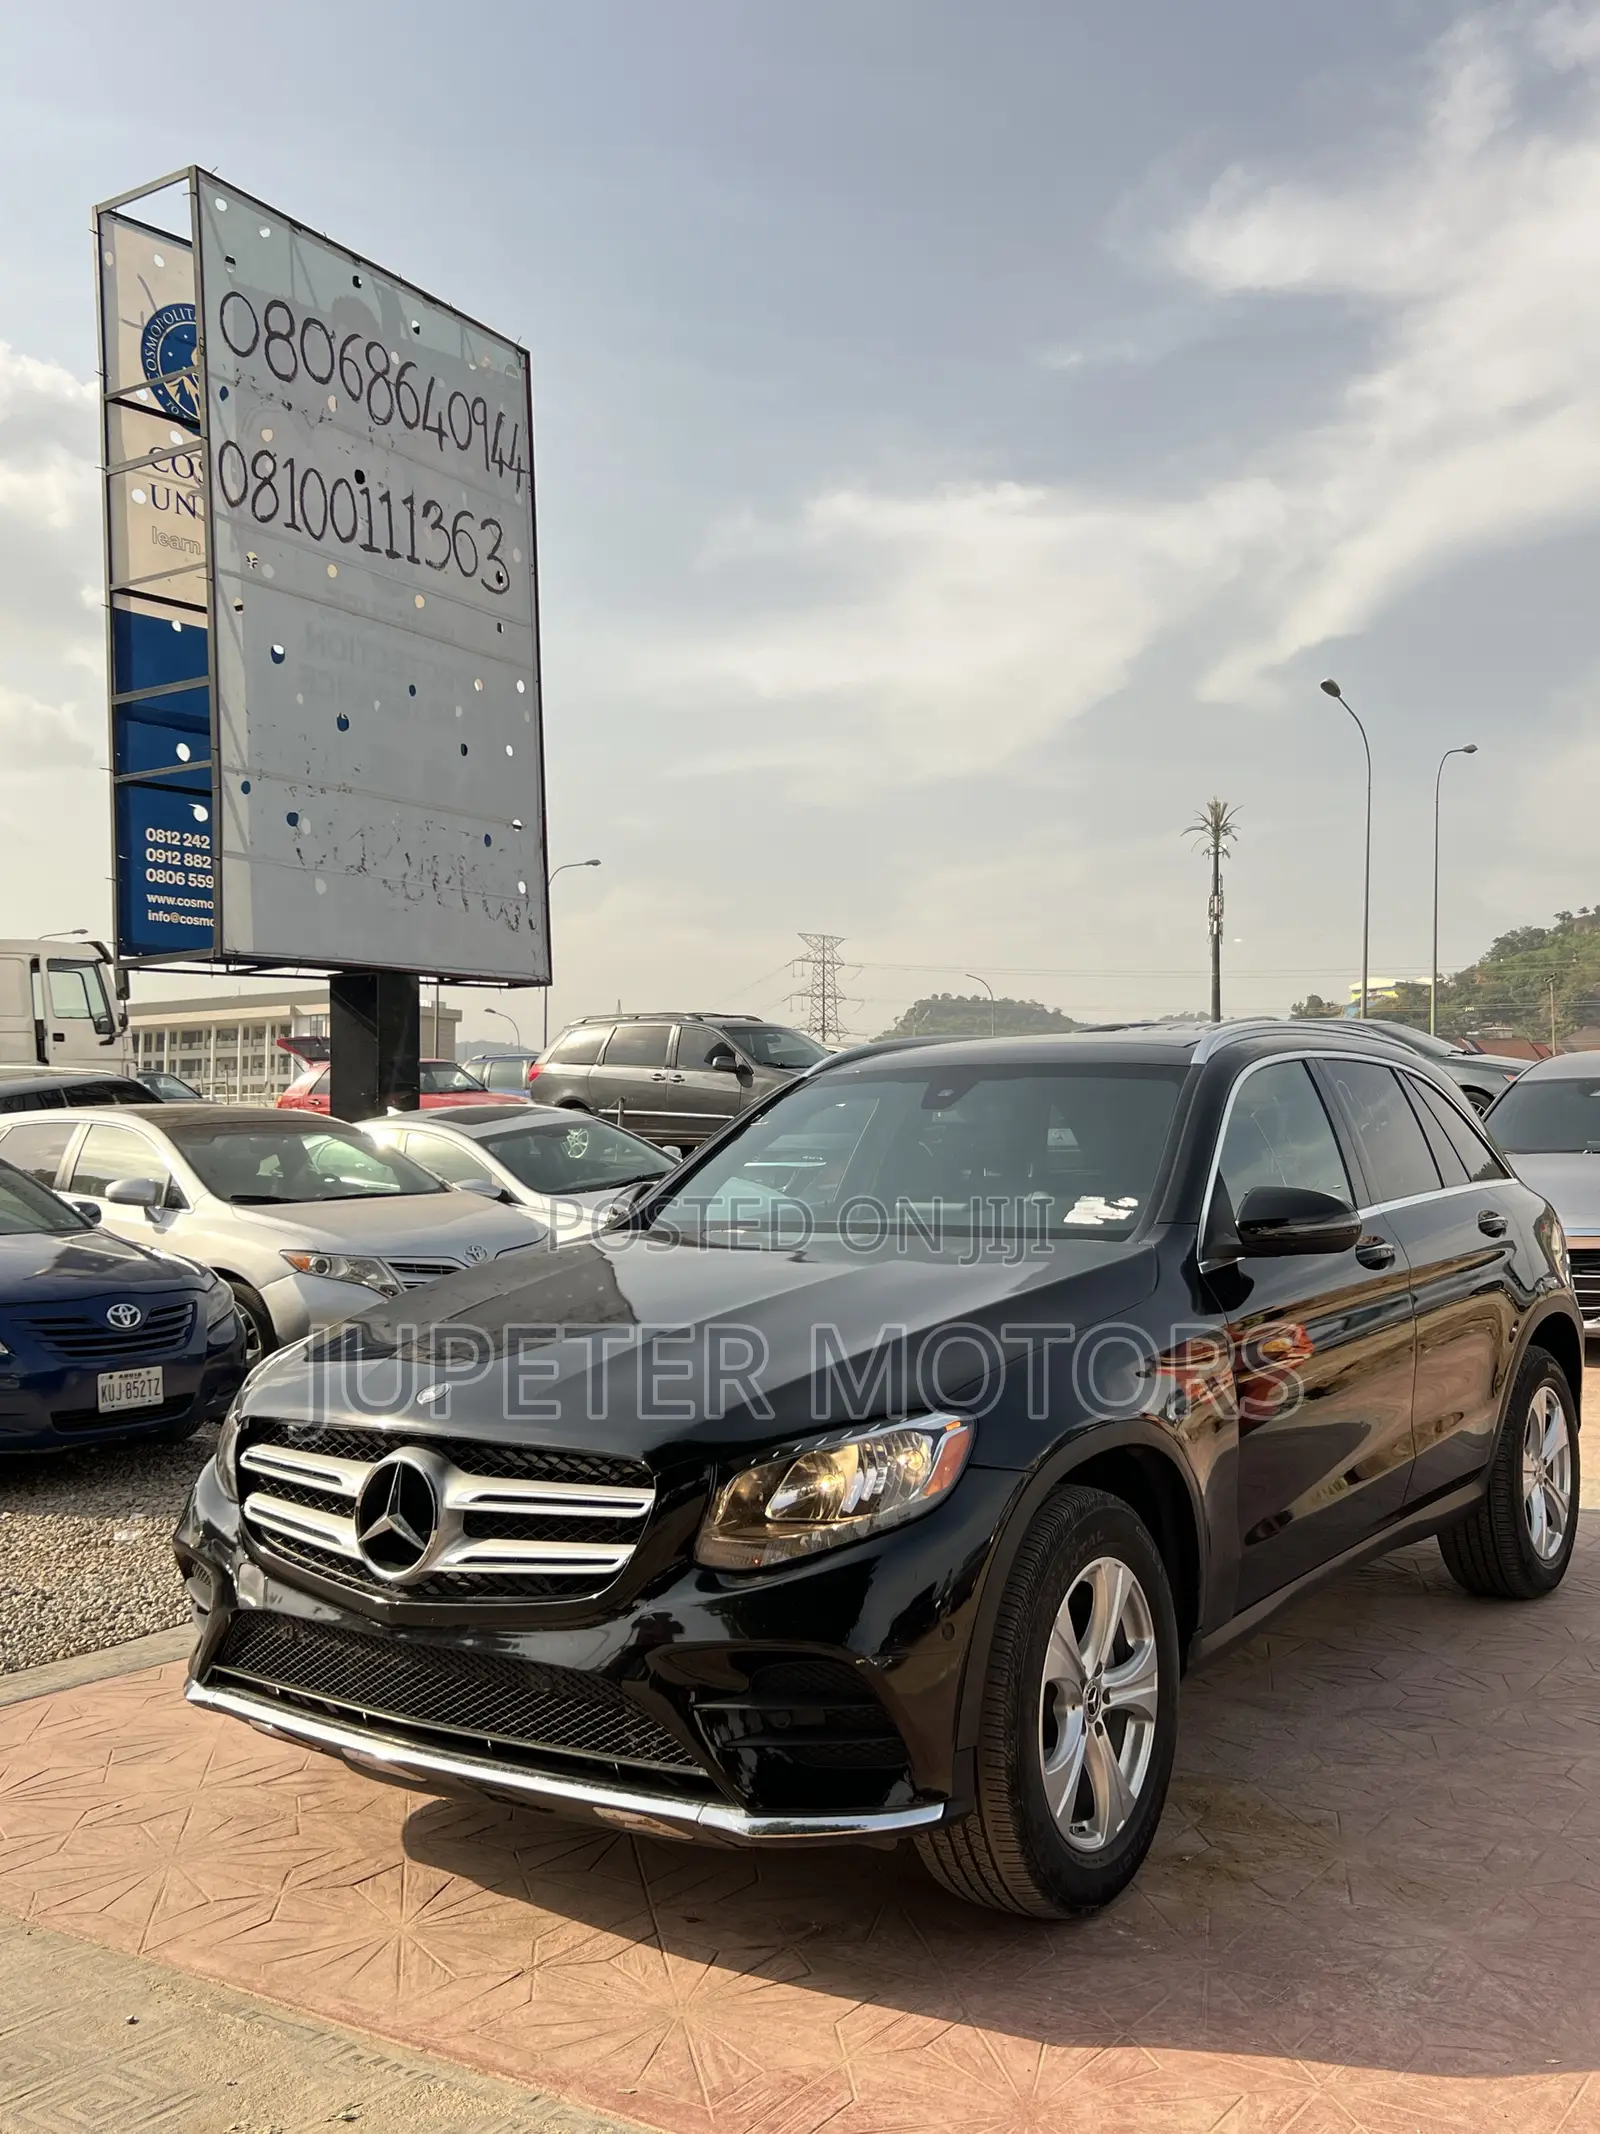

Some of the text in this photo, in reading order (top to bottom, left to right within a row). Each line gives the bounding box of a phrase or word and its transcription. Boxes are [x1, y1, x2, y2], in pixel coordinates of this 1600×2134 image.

[145, 307, 197, 380] COSMOPOLIT
[220, 291, 530, 493] 08068640944
[219, 440, 510, 595] 08100111363
[145, 827, 211, 849] 0812 242
[145, 847, 212, 869] 0912 882
[145, 867, 214, 889] 0806 559
[146, 894, 215, 909] www.cosmo
